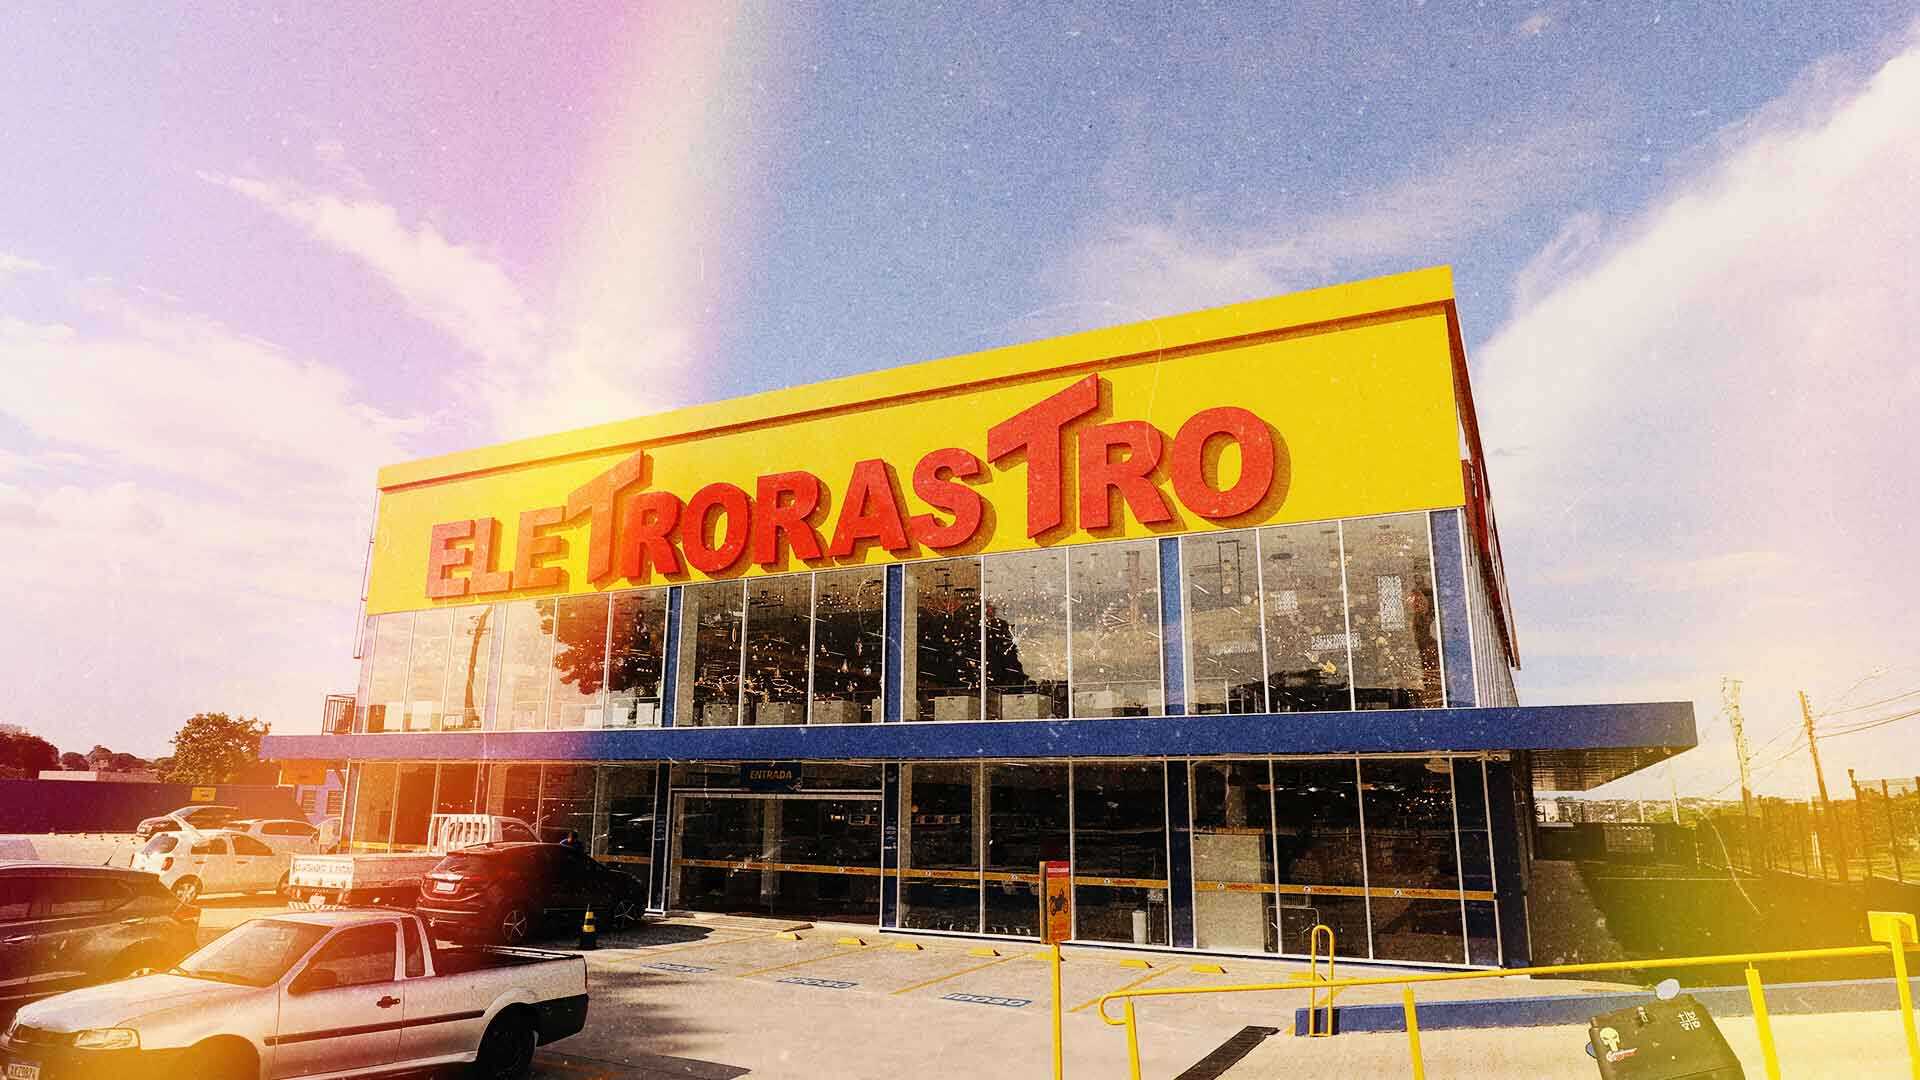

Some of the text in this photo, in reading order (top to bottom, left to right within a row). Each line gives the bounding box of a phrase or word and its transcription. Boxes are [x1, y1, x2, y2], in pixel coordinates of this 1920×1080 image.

[425, 373, 1275, 599] ELETRORASTRO
[750, 769, 792, 780] ENTRADA
[943, 994, 1027, 1007] IDOSO
